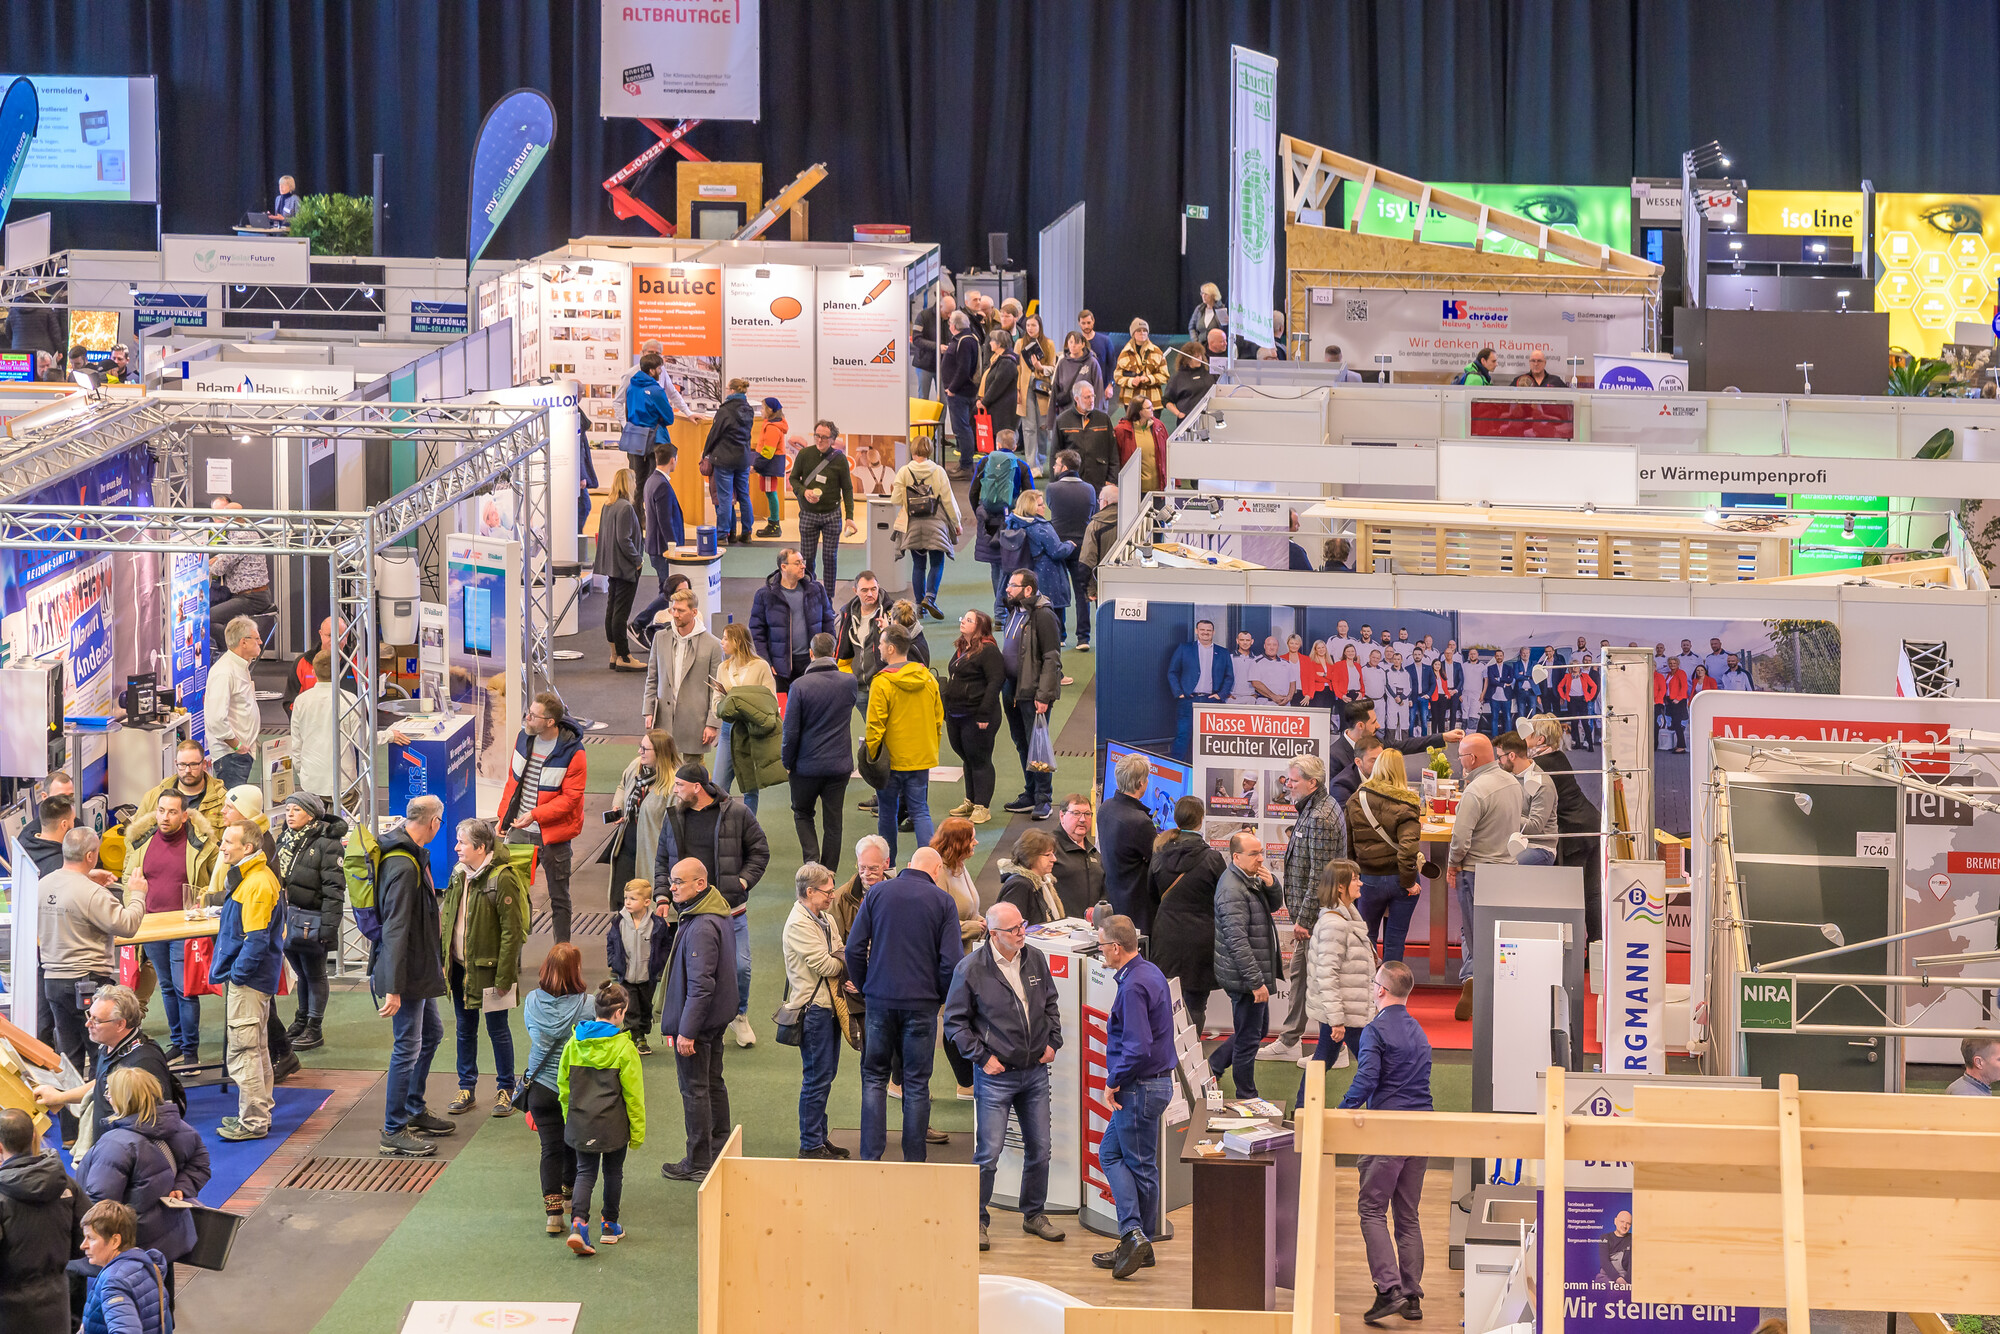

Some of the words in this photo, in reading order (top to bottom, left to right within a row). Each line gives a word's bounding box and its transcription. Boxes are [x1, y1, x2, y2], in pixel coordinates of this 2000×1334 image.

[623, 7, 731, 24] ALTBAUTAGE
[624, 65, 651, 77] energie
[625, 72, 652, 83] konsens
[609, 141, 665, 184] TEL.:04221
[672, 124, 688, 139] 97
[484, 142, 534, 214] mySolarFuture
[1646, 198, 1682, 206] WESSEN
[1781, 207, 1852, 229] isoline
[219, 254, 275, 263] mySolarFuture
[639, 275, 716, 295] bautec
[823, 300, 860, 311] planen.
[1443, 300, 1467, 320] HS
[432, 317, 467, 326] PERSÖNLIC
[731, 316, 774, 326] beraten.
[1469, 312, 1509, 321] chröder
[1578, 312, 1616, 320] Badmanager
[414, 325, 468, 334] MINI-SOLARANLA
[1442, 321, 1471, 329] Heizung
[1482, 321, 1509, 329] Sanitär
[1409, 337, 1430, 348] Wir
[1434, 338, 1479, 349] denken
[1484, 338, 1494, 349] in
[1500, 339, 1554, 351] Räumen.
[832, 356, 867, 366] bauen.
[196, 382, 234, 392] Adam
[533, 394, 578, 407] VALLOX
[1640, 469, 1656, 479] er
[1662, 467, 1827, 485] Wärmepumpenprofi
[174, 553, 200, 572] Anders
[428, 608, 443, 616] Vaillant
[1120, 608, 1141, 617] 7C30
[72, 613, 100, 653] Warum
[76, 632, 111, 682] Anders?
[1205, 714, 1246, 733] Nasse
[1250, 716, 1305, 735] Wände?
[1205, 736, 1264, 755] Feuchter
[1269, 738, 1315, 757] Keller?
[1911, 783, 1960, 818] ler?
[1863, 846, 1889, 856] 7C40
[1632, 889, 1643, 903] B
[1744, 985, 1791, 1002] NIRA
[1624, 942, 1649, 1070] RGMANN
[1596, 1099, 1608, 1115] B
[1563, 1282, 1588, 1290] omm
[1592, 1280, 1606, 1291] ins
[1604, 1298, 1684, 1320] stellen
[1692, 1304, 1737, 1322] ein!
